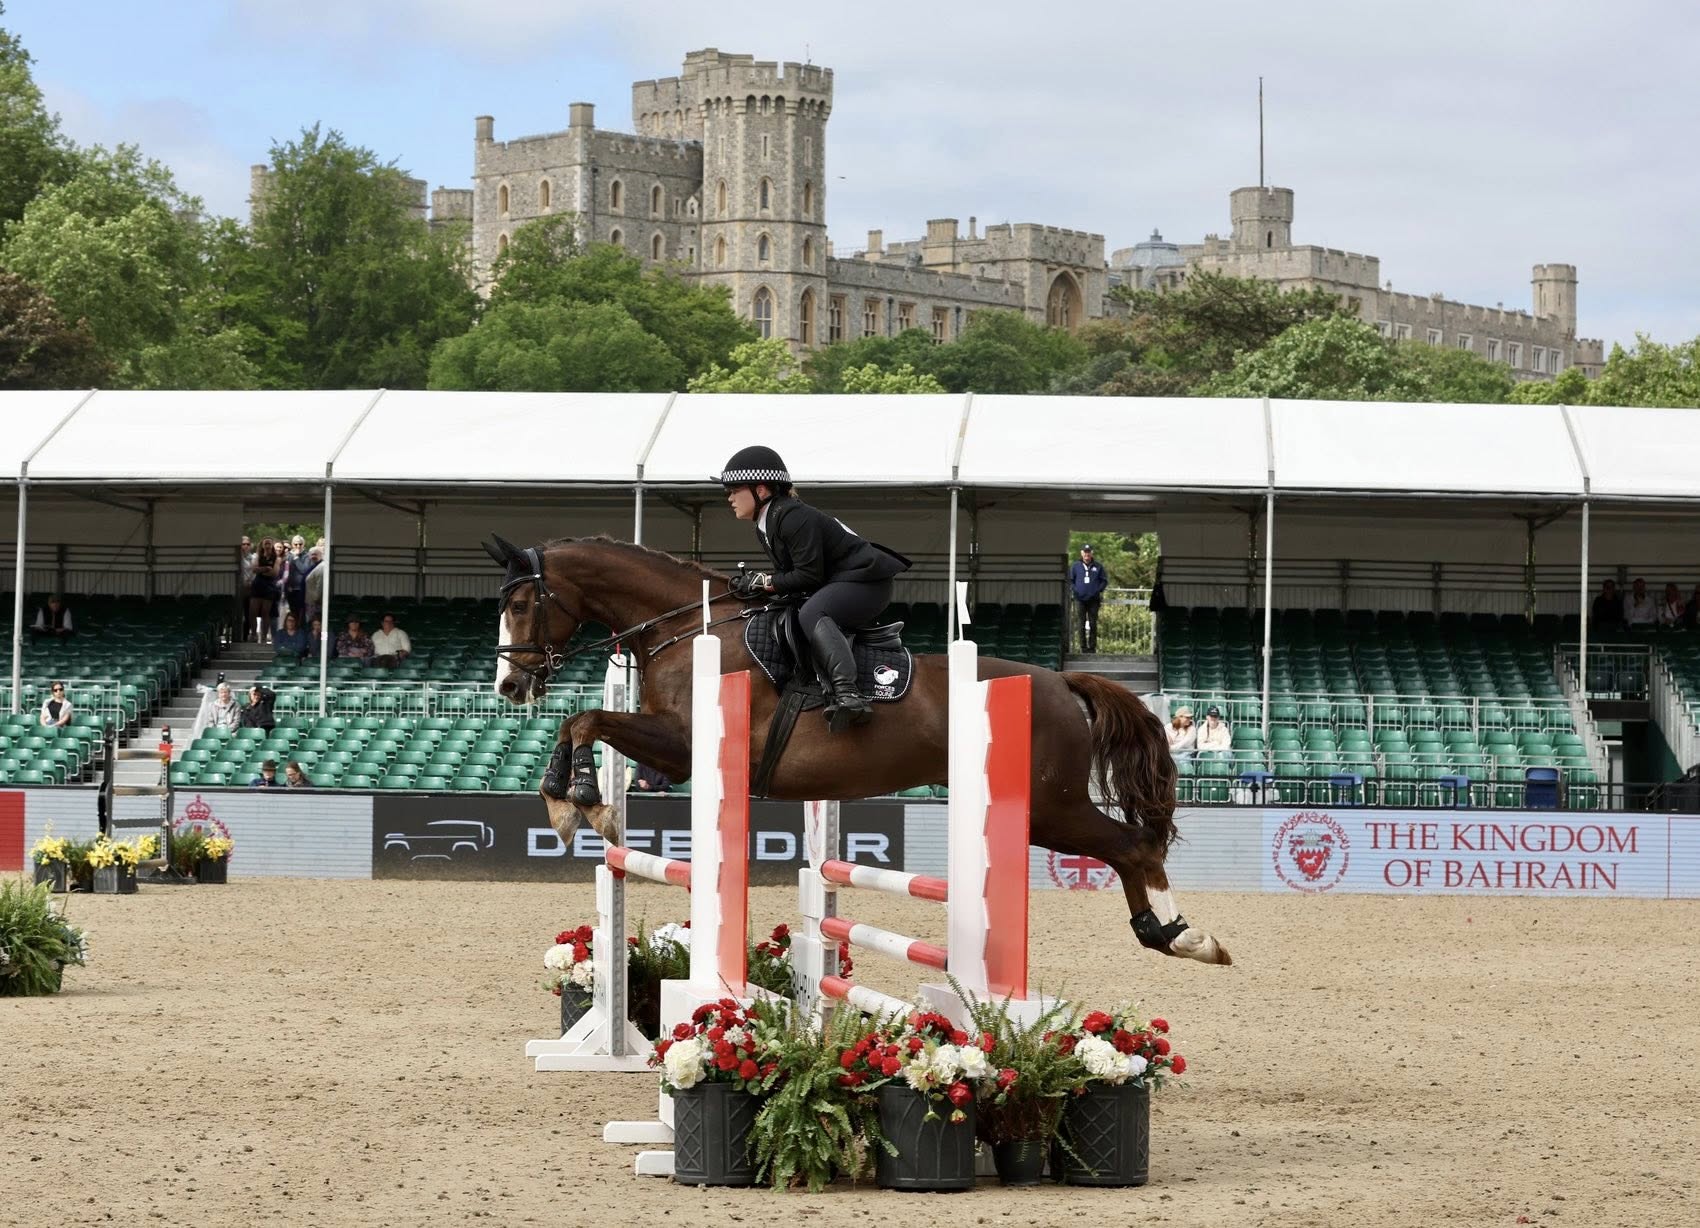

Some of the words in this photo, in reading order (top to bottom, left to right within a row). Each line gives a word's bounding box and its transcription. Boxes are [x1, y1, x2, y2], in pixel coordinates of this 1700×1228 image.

[527, 827, 890, 862] DEFEDR
[1366, 822, 1439, 850] THE
[1450, 824, 1639, 853] KINGDOM
[1383, 859, 1431, 887] OF
[1443, 861, 1618, 890] BAHRAIN
